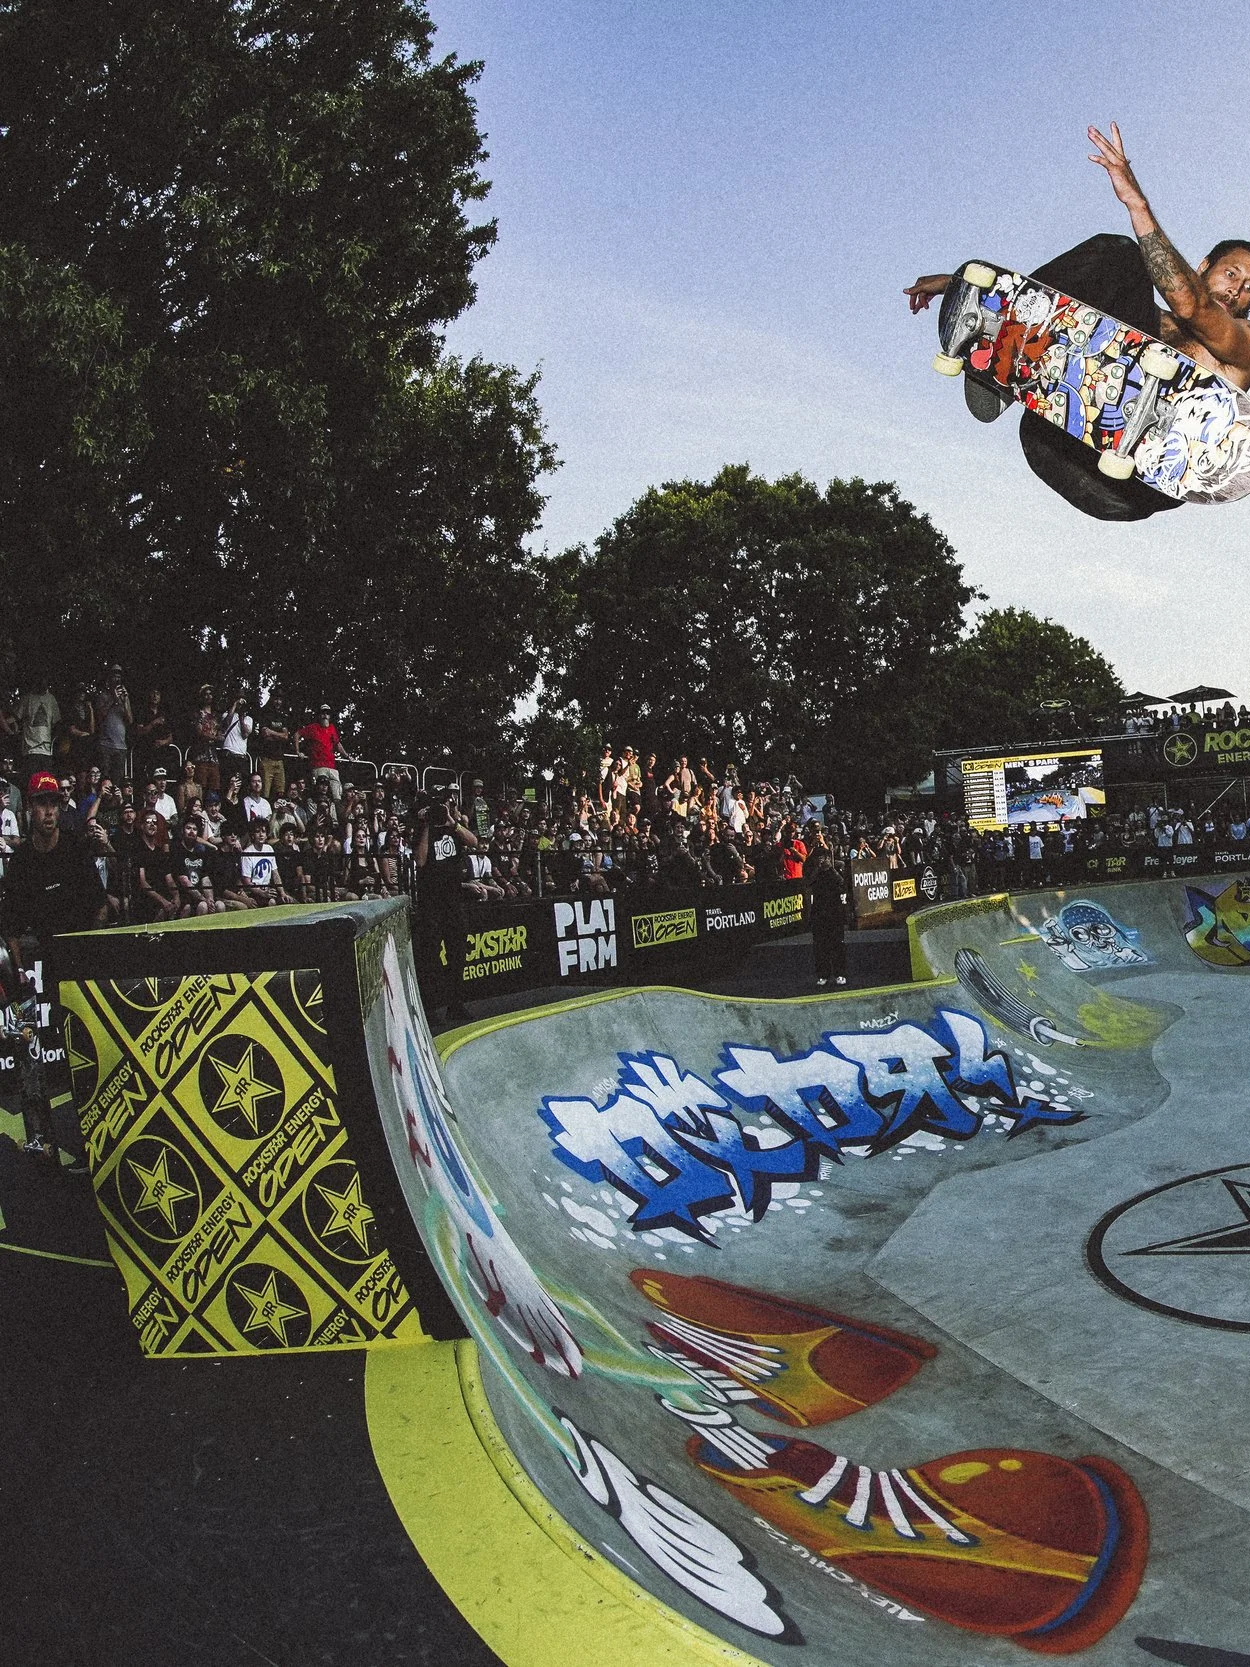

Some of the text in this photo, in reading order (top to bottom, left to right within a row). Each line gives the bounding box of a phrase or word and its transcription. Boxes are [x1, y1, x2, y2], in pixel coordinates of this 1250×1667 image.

[1035, 758, 1059, 766] PARK
[854, 871, 888, 887] PORTLAND
[706, 911, 756, 931] PORTLAND
[763, 893, 803, 918] ROCKSTAR
[770, 912, 802, 929] ENERGY DRINK
[654, 918, 696, 941] OPEN
[492, 955, 522, 975] DRINK
[558, 934, 617, 976] FRM
[139, 1000, 185, 1057] ROCKSTAR
[155, 974, 237, 1079] OPEN
[98, 1061, 133, 1109] ENERGY
[241, 1087, 325, 1188] ROCKSTAR ENERGY
[259, 1098, 341, 1207] OPEN
[166, 1191, 238, 1285] ROCKSTAR ENERGY
[182, 1201, 253, 1305] OPEN
[132, 1287, 166, 1329] ENERGY
